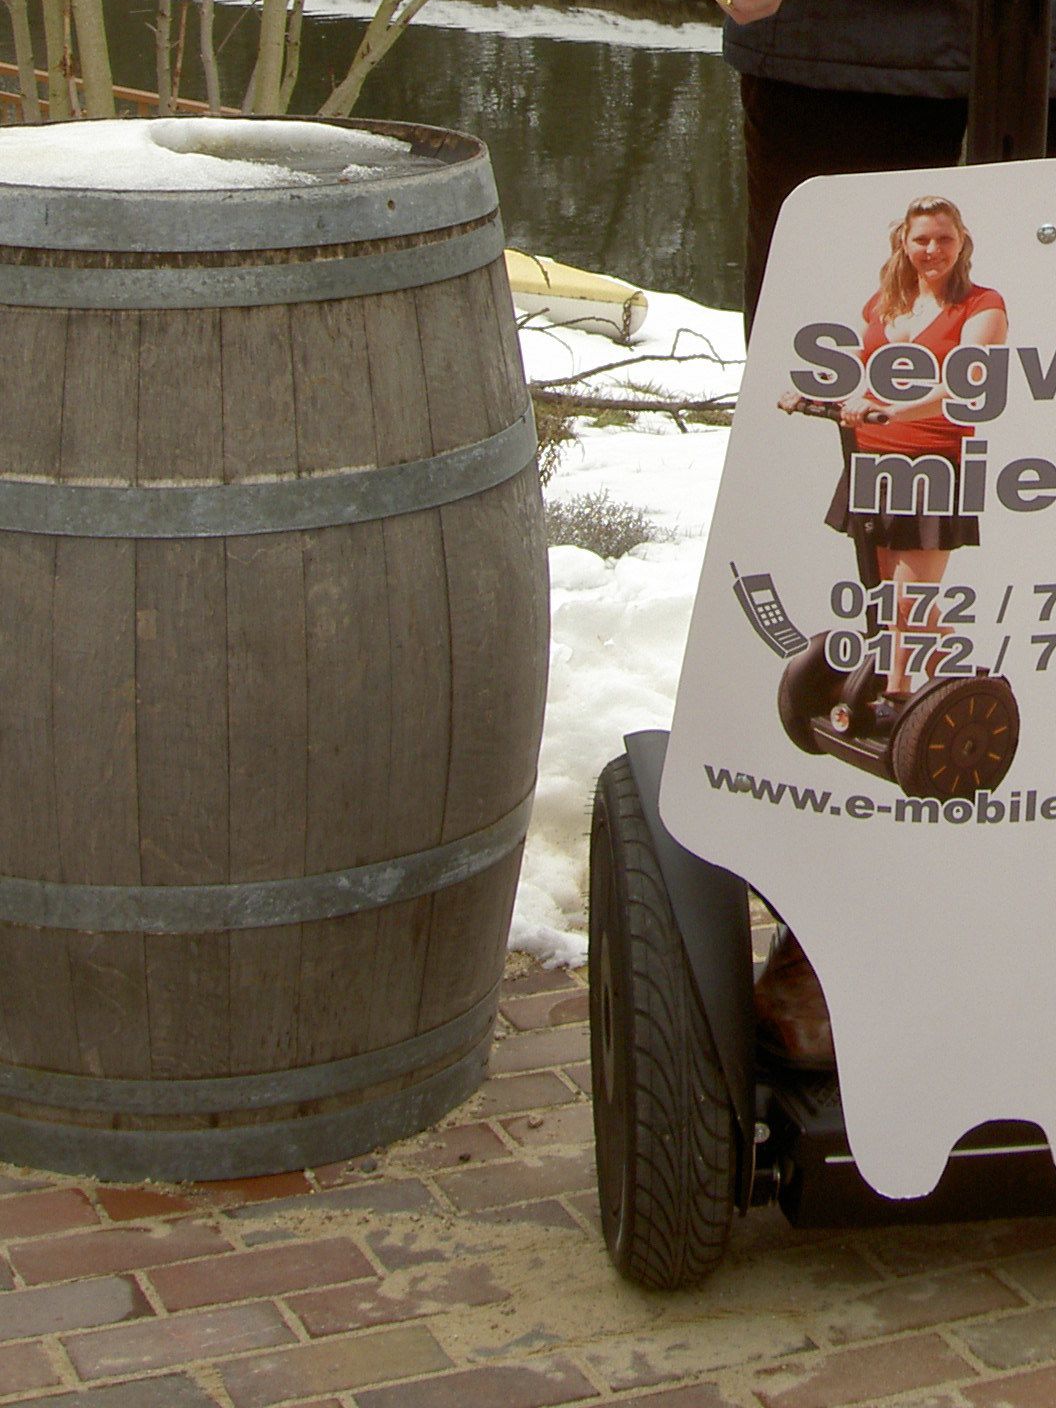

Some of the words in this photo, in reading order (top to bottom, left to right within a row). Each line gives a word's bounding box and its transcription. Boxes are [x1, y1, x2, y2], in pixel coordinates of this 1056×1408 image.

[829, 580, 977, 624] 0172
[997, 585, 1014, 624] /
[828, 630, 976, 674] 0172
[995, 637, 1012, 675] /
